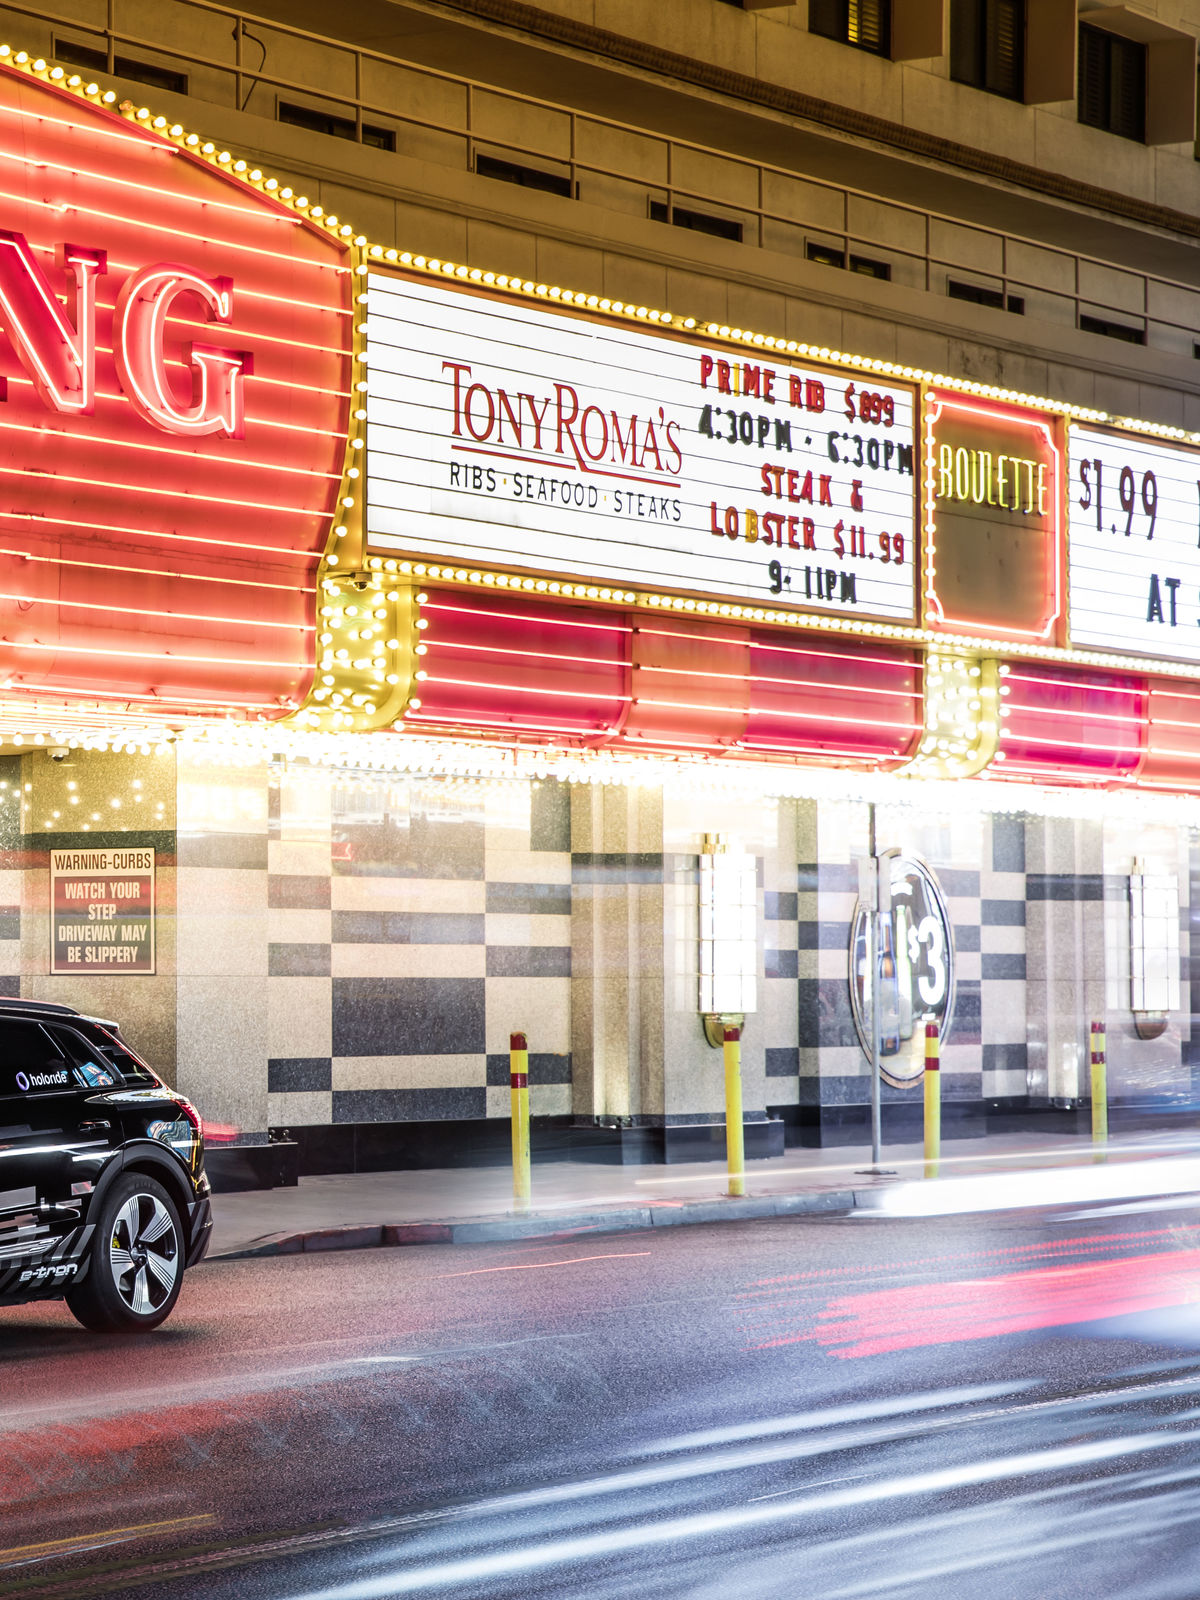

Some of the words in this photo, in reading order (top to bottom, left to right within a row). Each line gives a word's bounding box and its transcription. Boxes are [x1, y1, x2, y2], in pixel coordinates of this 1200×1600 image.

[700, 354, 776, 404] PRIME
[789, 373, 825, 413] RIB
[844, 382, 895, 428] $899
[699, 403, 793, 452] 4:30PM
[827, 430, 914, 476] 6:30PM
[449, 461, 496, 493] RIBS
[513, 472, 598, 508] SEAFOOD
[614, 490, 682, 522] STEAKS
[761, 462, 833, 507] STEAK
[936, 444, 1048, 516] ROULETTE
[1079, 458, 1158, 541] $1.99
[710, 501, 817, 551] LOBSTER
[833, 519, 905, 566] $11.99
[1146, 573, 1181, 627] AT
[54, 852, 151, 871] WARNING-CURBS
[64, 882, 106, 899] WATCH
[109, 881, 141, 899] YOUR
[88, 903, 117, 920] STEP
[58, 925, 118, 941] DRIVEWAY
[121, 924, 147, 941] MAY
[67, 946, 82, 963] BE
[84, 946, 138, 963] SLIPPERY
[29, 1070, 68, 1087] holoride
[19, 1263, 79, 1281] e-tron
